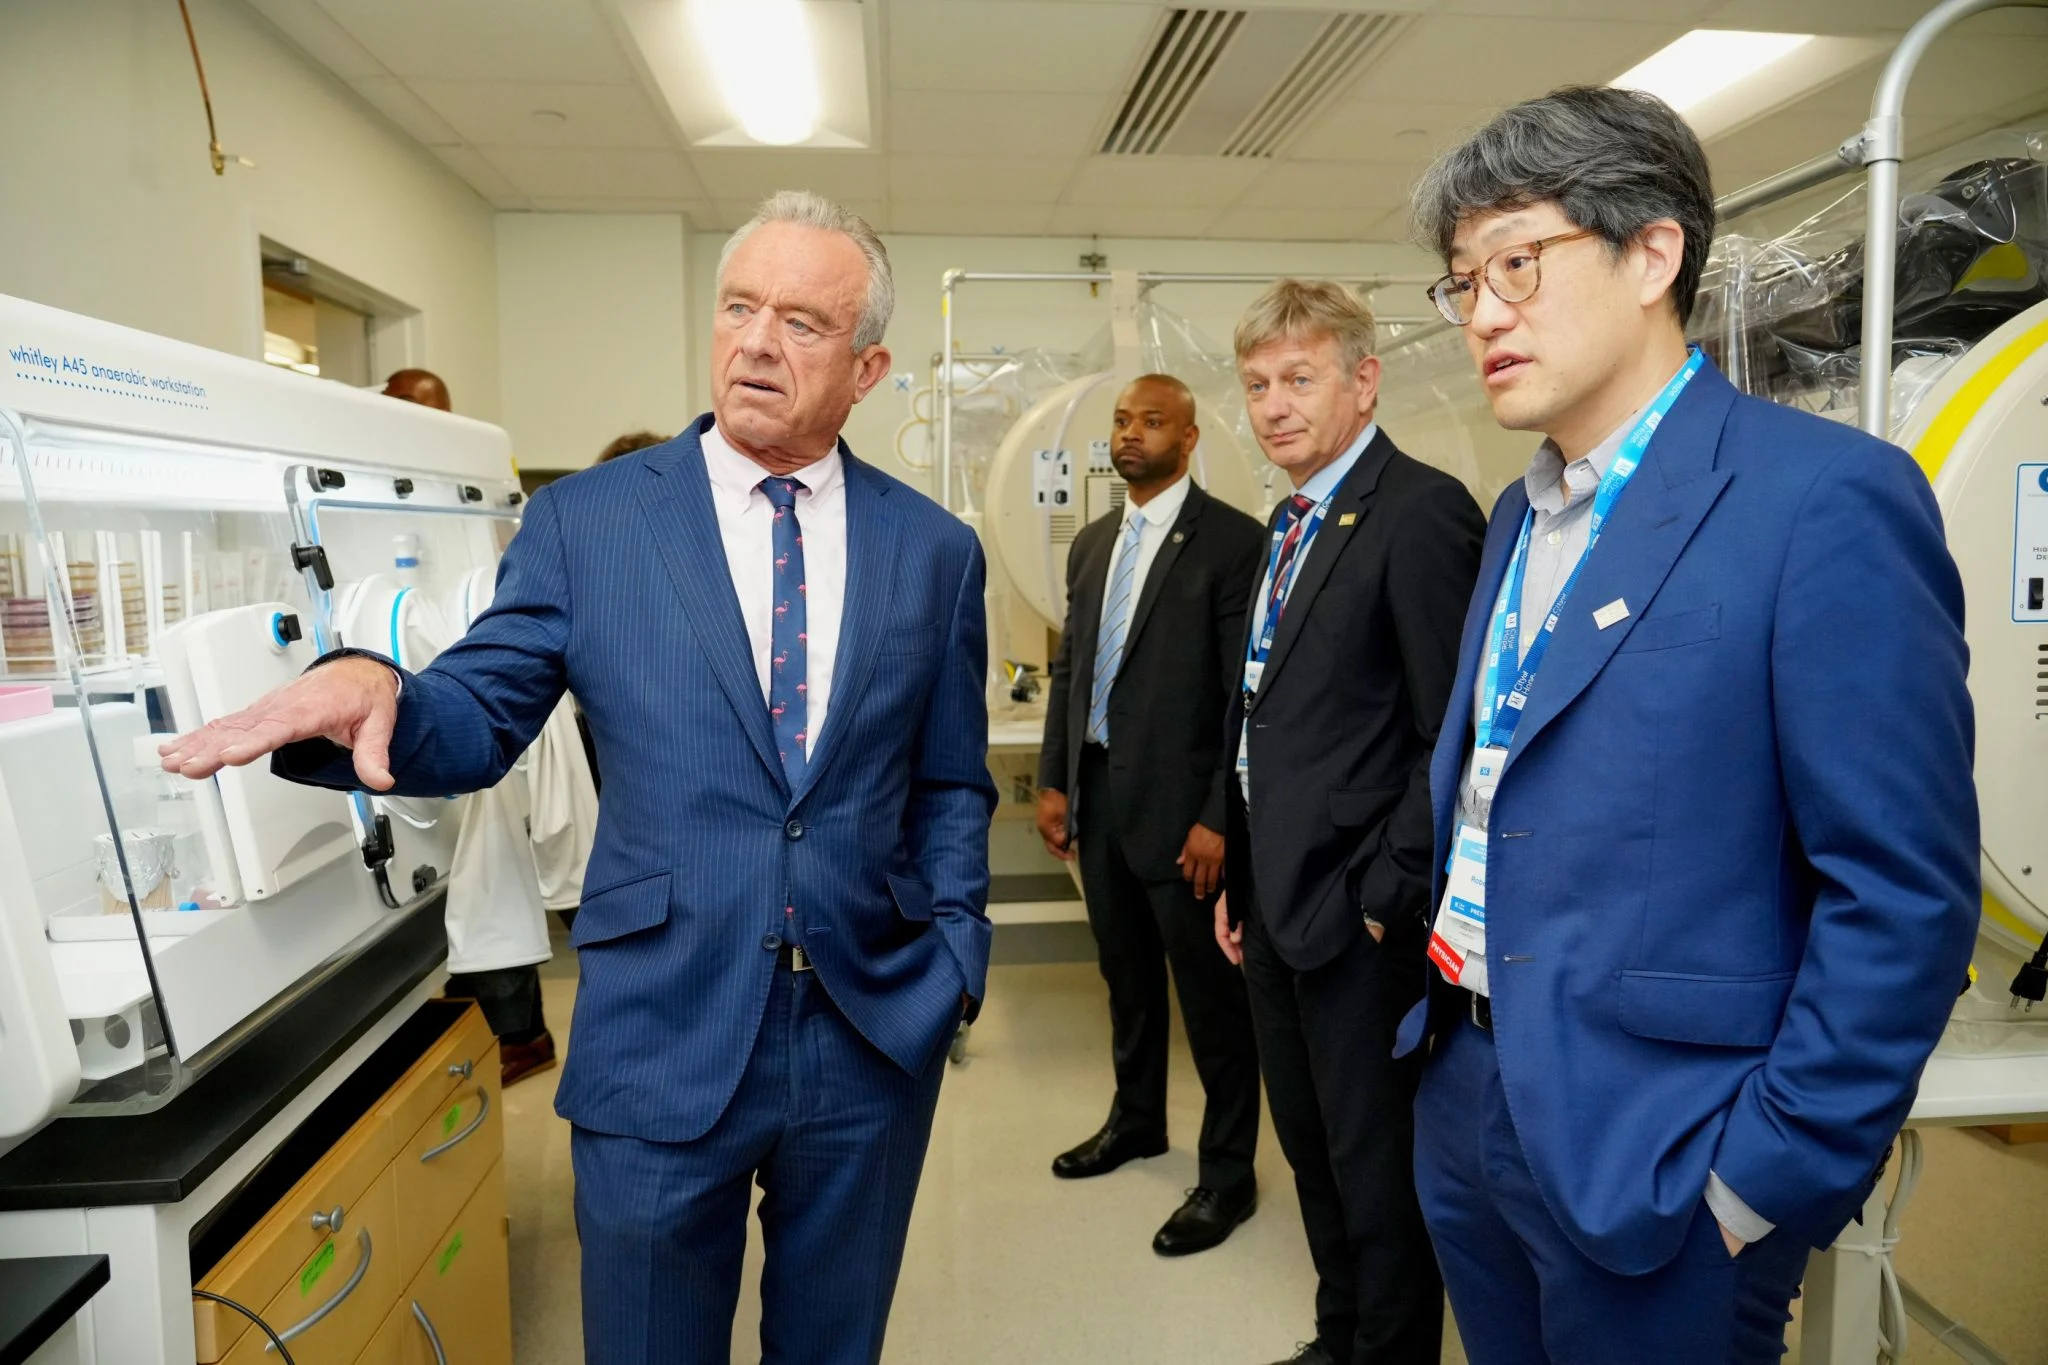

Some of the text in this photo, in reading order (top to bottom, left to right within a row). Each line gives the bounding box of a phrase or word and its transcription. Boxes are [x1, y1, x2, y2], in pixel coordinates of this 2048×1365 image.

[9, 346, 206, 398] whitley A45 anaerobic workstation
[1508, 629, 1517, 643] City
[1514, 676, 1527, 692] City
[1431, 941, 1459, 974] PHYSICIAN
